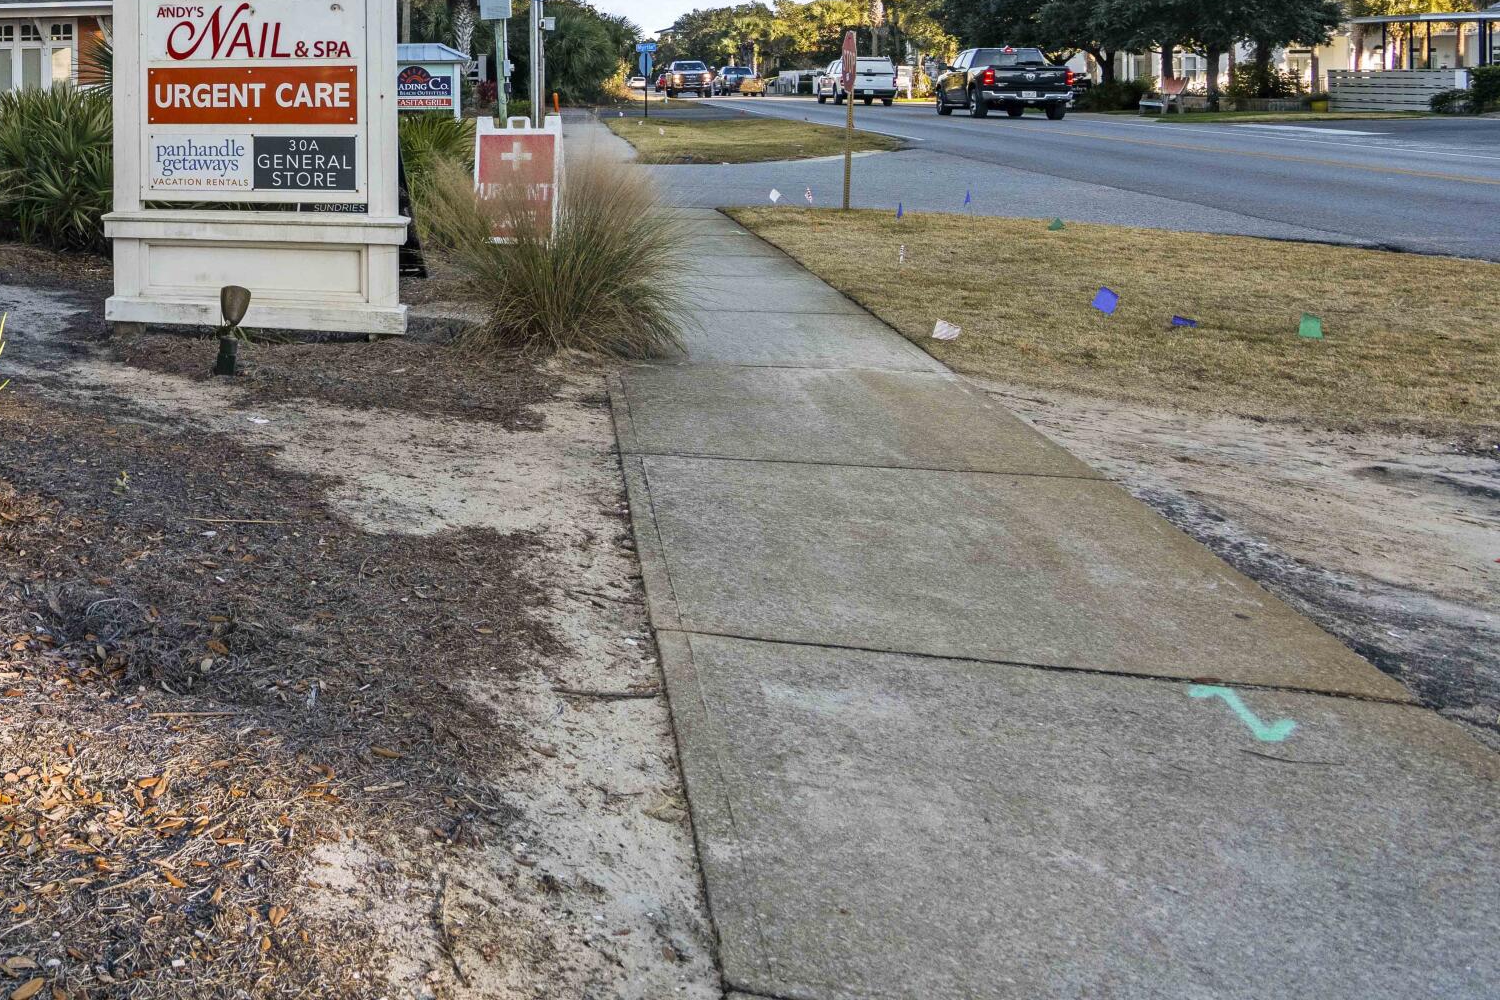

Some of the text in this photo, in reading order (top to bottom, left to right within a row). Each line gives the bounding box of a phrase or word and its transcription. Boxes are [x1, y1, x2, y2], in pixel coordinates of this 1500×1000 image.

[157, 6, 204, 18] ANDY'S
[166, 2, 351, 60] NAIL & SPA
[429, 77, 449, 90] Co.
[154, 82, 350, 108] URGENT CARE
[156, 139, 245, 163] panhandle
[288, 140, 319, 151] 30A
[162, 157, 239, 177] getaways
[257, 154, 352, 169] GENERAL
[152, 177, 249, 187] VACATION RENTALS
[272, 171, 337, 187] STORE
[314, 203, 365, 212] SUNDRIES
